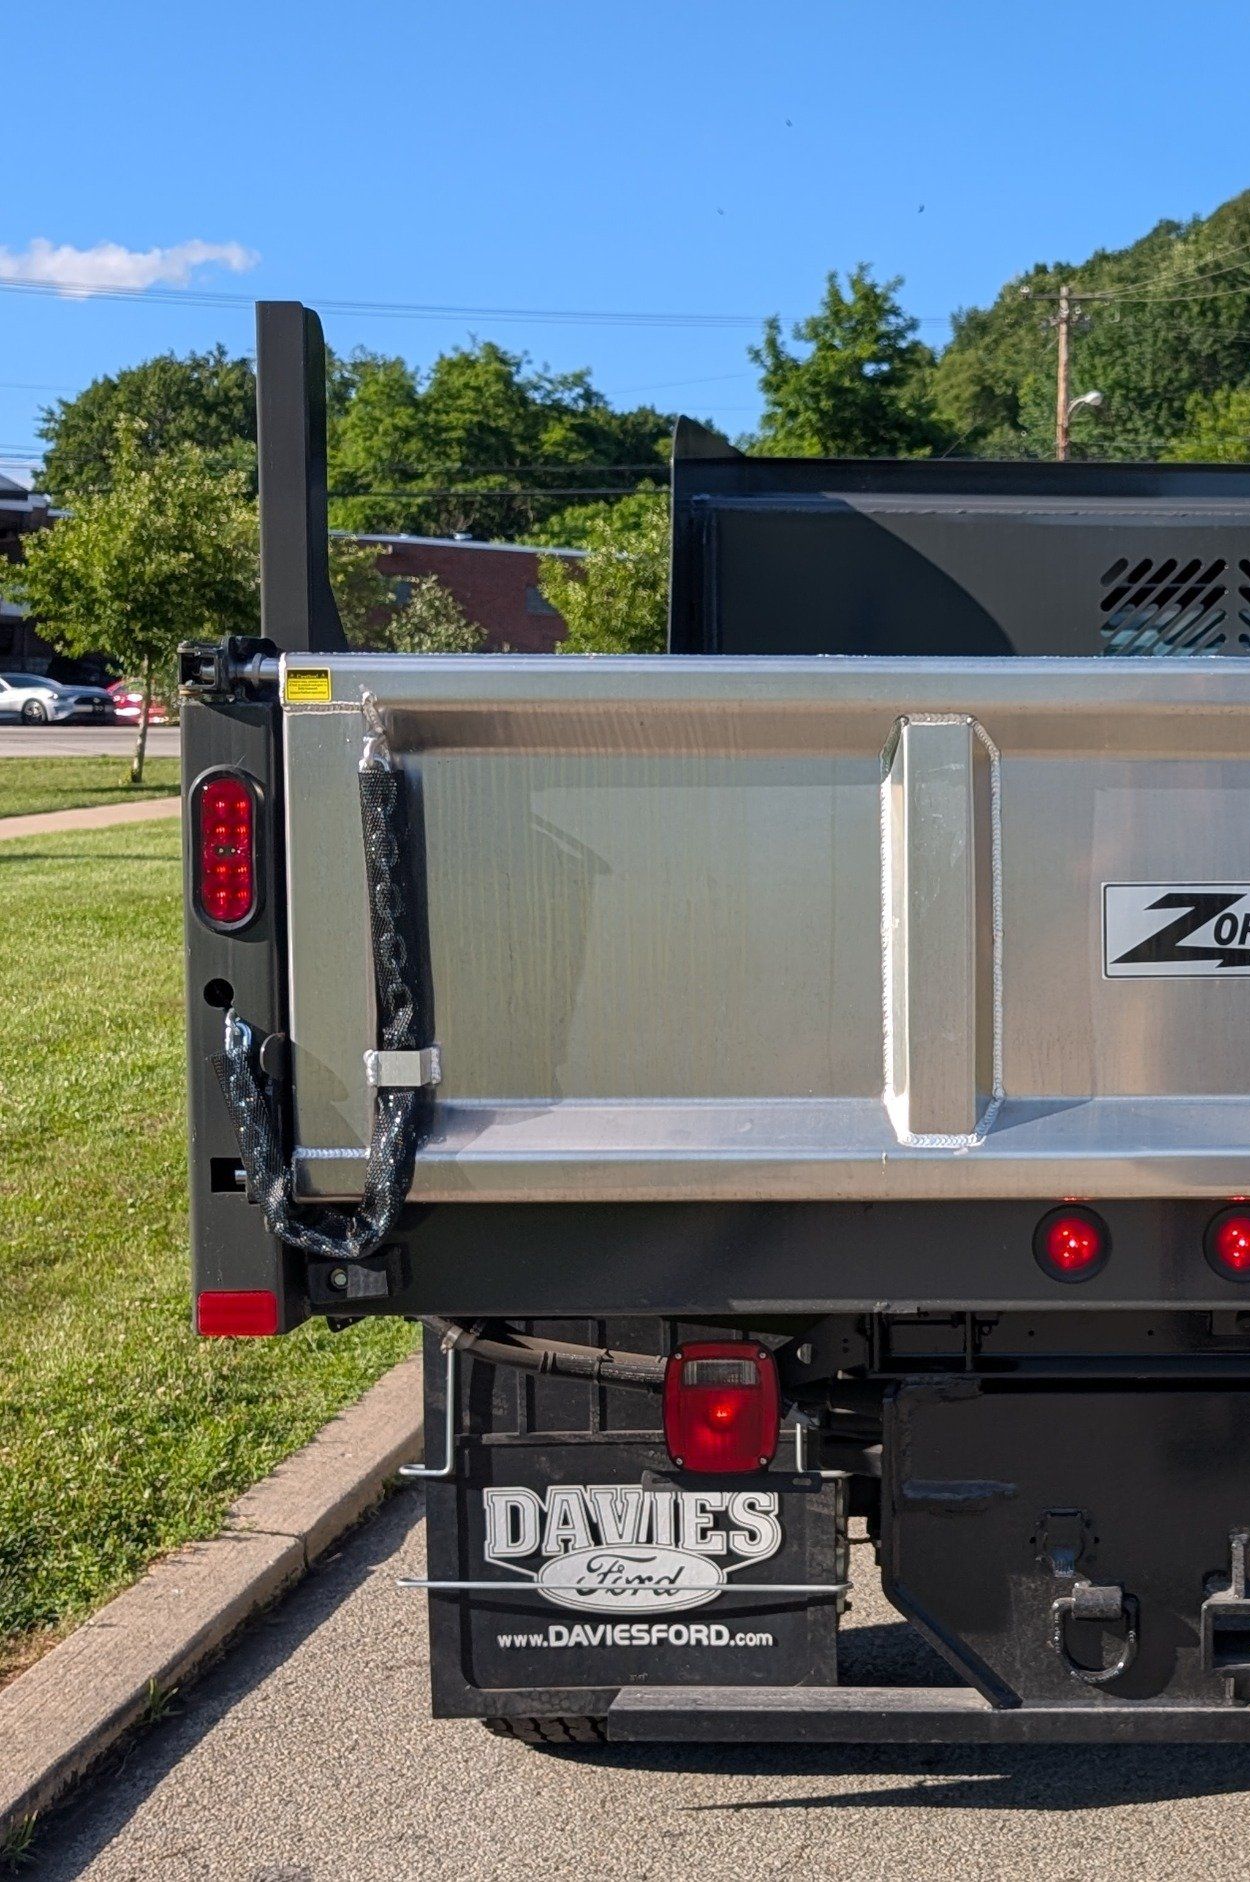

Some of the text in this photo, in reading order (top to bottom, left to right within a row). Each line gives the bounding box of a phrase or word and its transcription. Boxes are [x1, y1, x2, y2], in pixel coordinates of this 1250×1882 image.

[483, 1485, 782, 1558] DAVIES
[575, 1553, 686, 1598] Ford
[497, 1624, 774, 1649] www.DAVIESFORD.com
